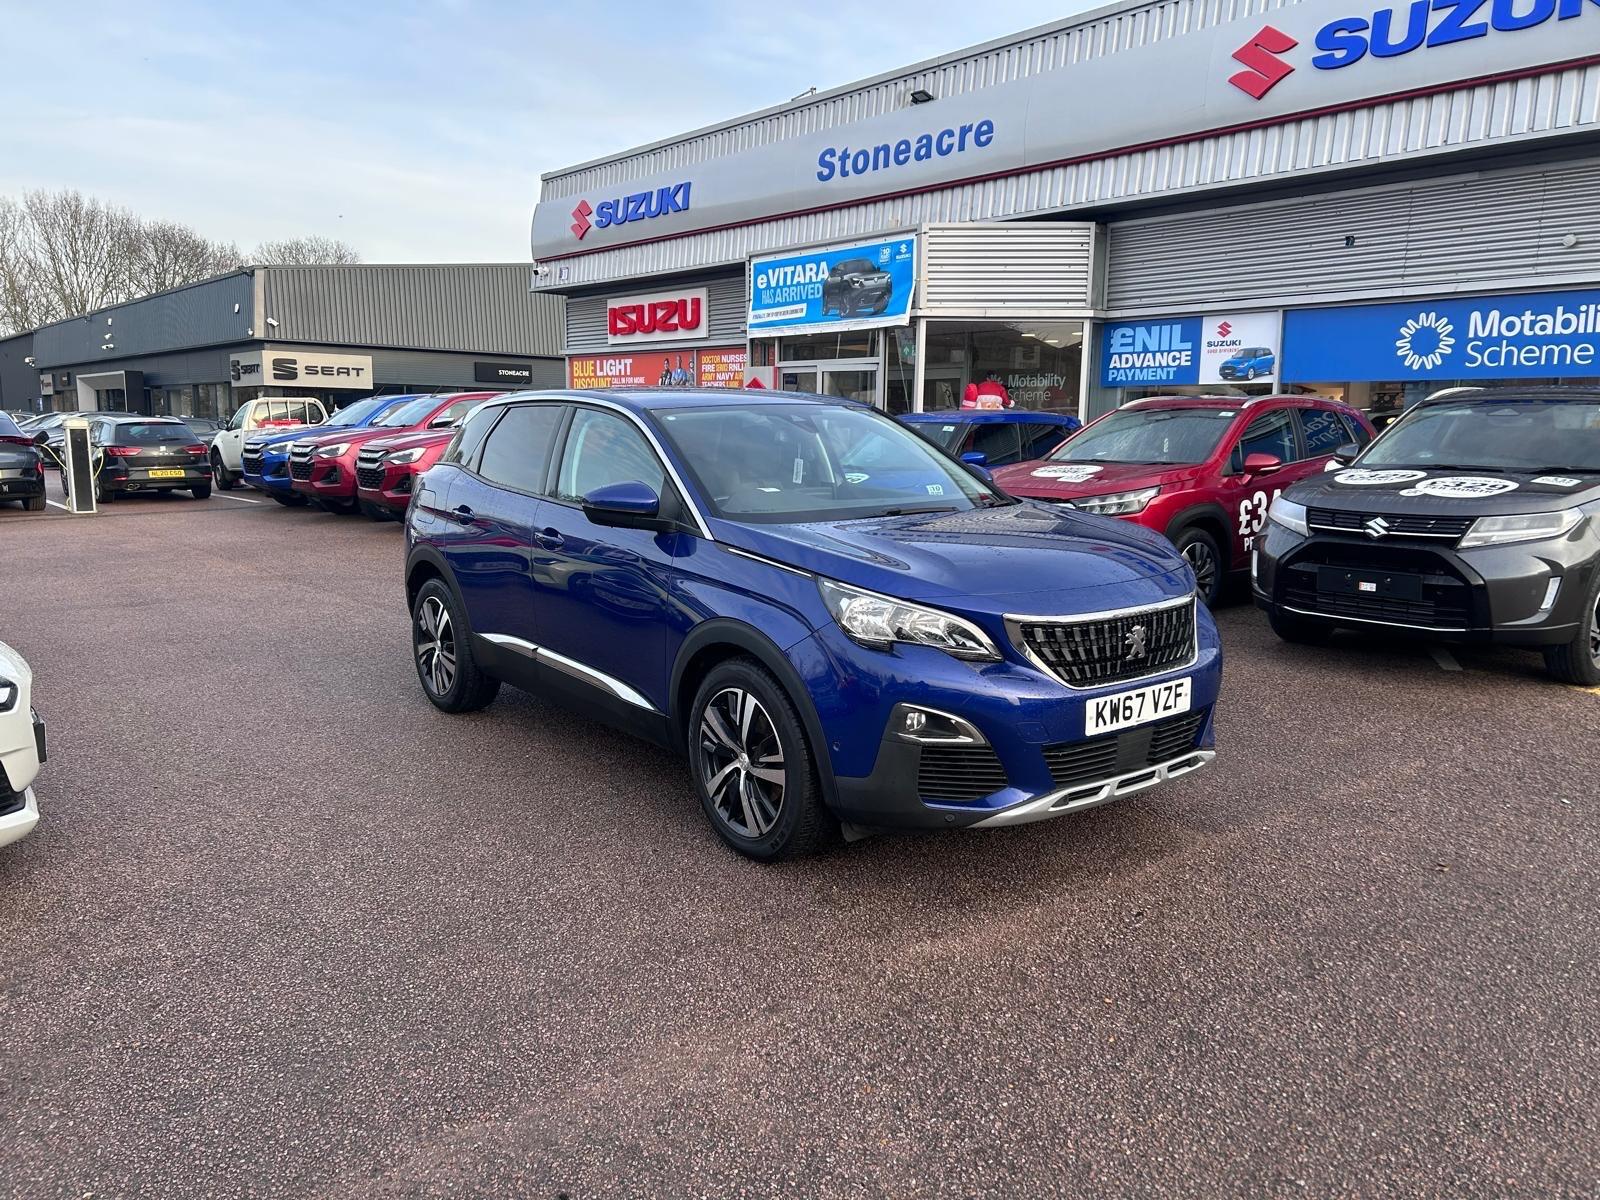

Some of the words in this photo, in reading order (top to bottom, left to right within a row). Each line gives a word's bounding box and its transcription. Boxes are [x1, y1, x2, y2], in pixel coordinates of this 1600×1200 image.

[816, 119, 994, 182] Stoneacre
[595, 182, 692, 228] SUZUKI
[761, 289, 774, 305] HAS
[774, 284, 823, 303] ARRIVED
[608, 298, 701, 335] ISUZU
[1110, 324, 1192, 353] £NIL
[1206, 340, 1242, 348] SUZUKI
[721, 353, 747, 363] NURSES
[1109, 351, 1191, 369] ADVANCE
[1465, 340, 1595, 367] Scheme
[240, 364, 259, 374] SEAT
[304, 365, 364, 377] SEAT
[498, 369, 530, 377] STONEACRE
[573, 361, 594, 376] BLUE
[596, 359, 633, 376] LIGHT
[702, 364, 716, 372] FIRE
[716, 372, 734, 380] NAVY
[1108, 367, 1177, 382] PAYMENT
[573, 377, 612, 389] DISCOUNT
[1008, 372, 1066, 390] Motability
[1008, 389, 1051, 401] Scheme
[1238, 489, 1282, 536] £3
[1095, 692, 1146, 728] KW67
[1152, 682, 1184, 713] VZF
